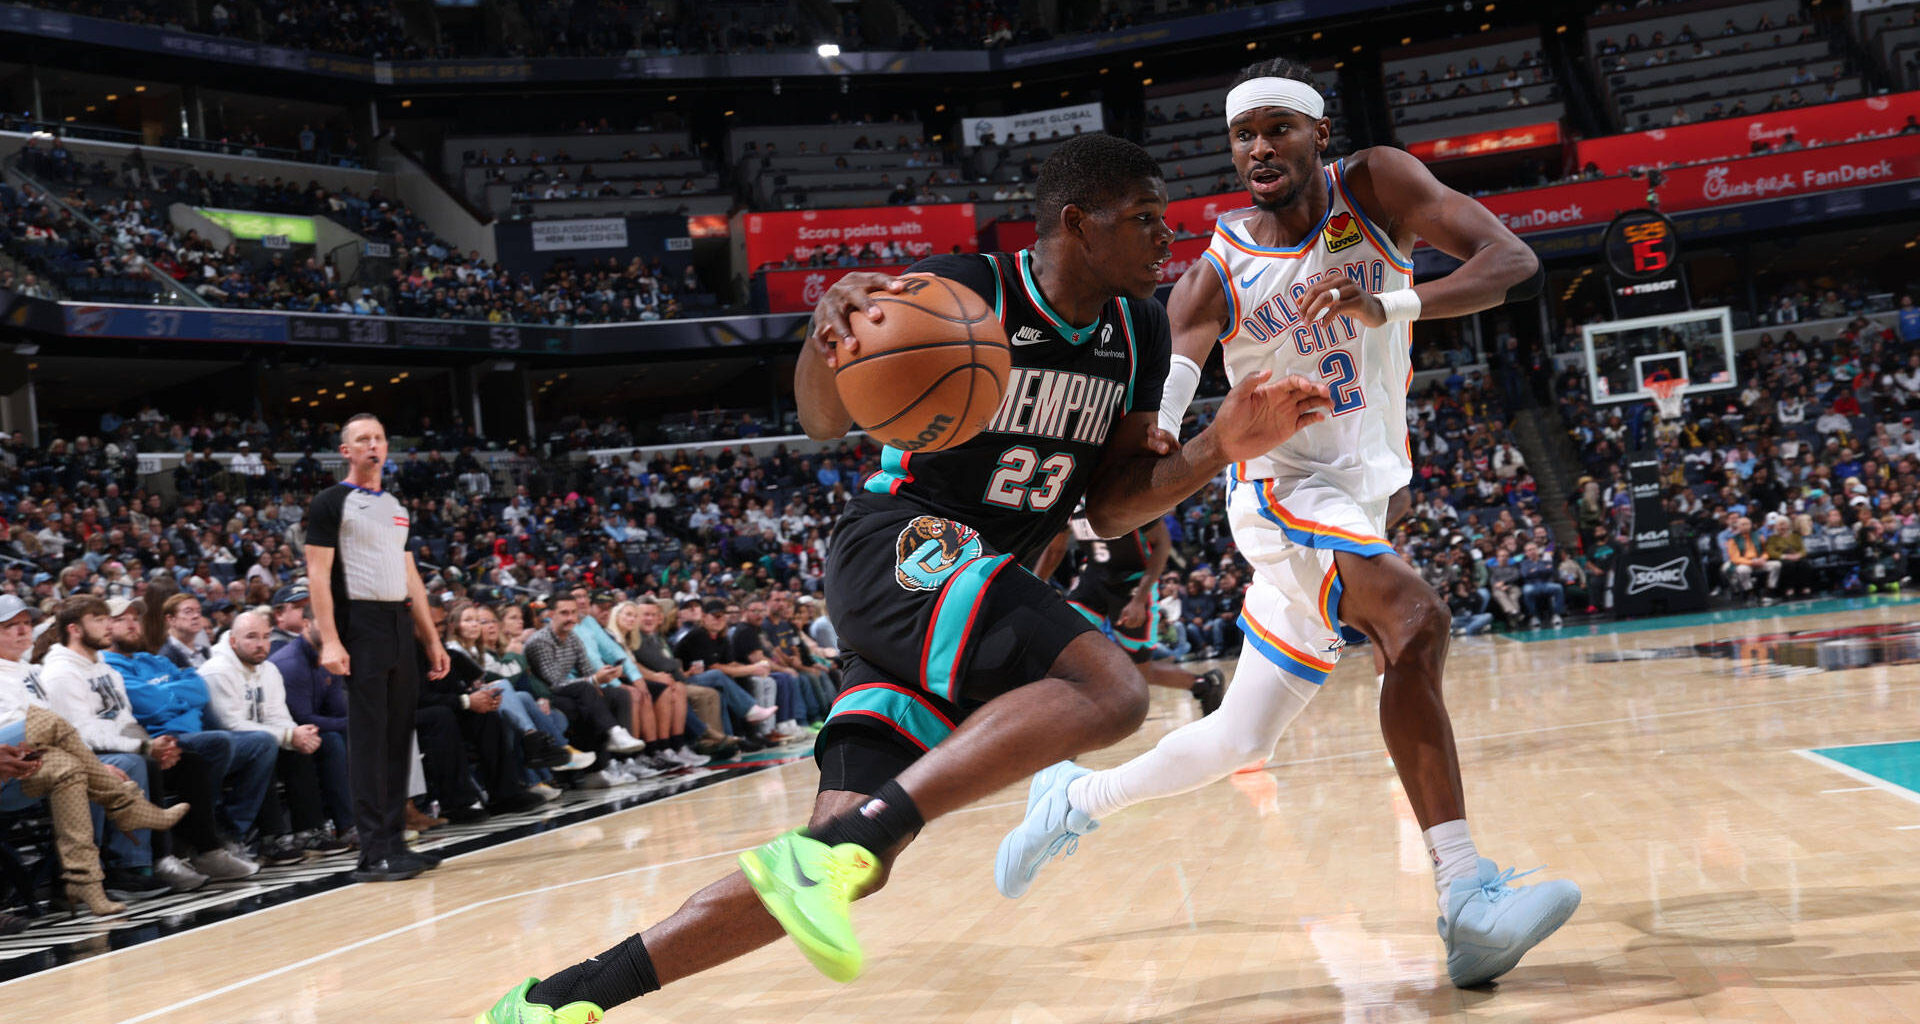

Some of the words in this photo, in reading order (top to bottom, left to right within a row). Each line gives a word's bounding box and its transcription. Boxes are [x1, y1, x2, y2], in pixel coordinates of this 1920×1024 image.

[1015, 118, 1045, 127] PRIME
[1049, 110, 1092, 123] GLOBAL
[1803, 159, 1894, 188] FanDeck
[1498, 204, 1585, 230] FanDeck
[797, 226, 840, 240] Score
[844, 223, 888, 240] points
[891, 221, 922, 235] with
[1634, 279, 1679, 295] TISSOT
[145, 311, 181, 336] 37
[1016, 325, 1043, 341] NIKE
[489, 326, 521, 349] 53
[1094, 348, 1125, 359] Robinhood
[1318, 349, 1367, 417] 2
[981, 366, 1126, 446] MEMPHIS
[982, 445, 1077, 512] 23
[1092, 541, 1111, 563] 5
[1636, 569, 1682, 585] SONIC
